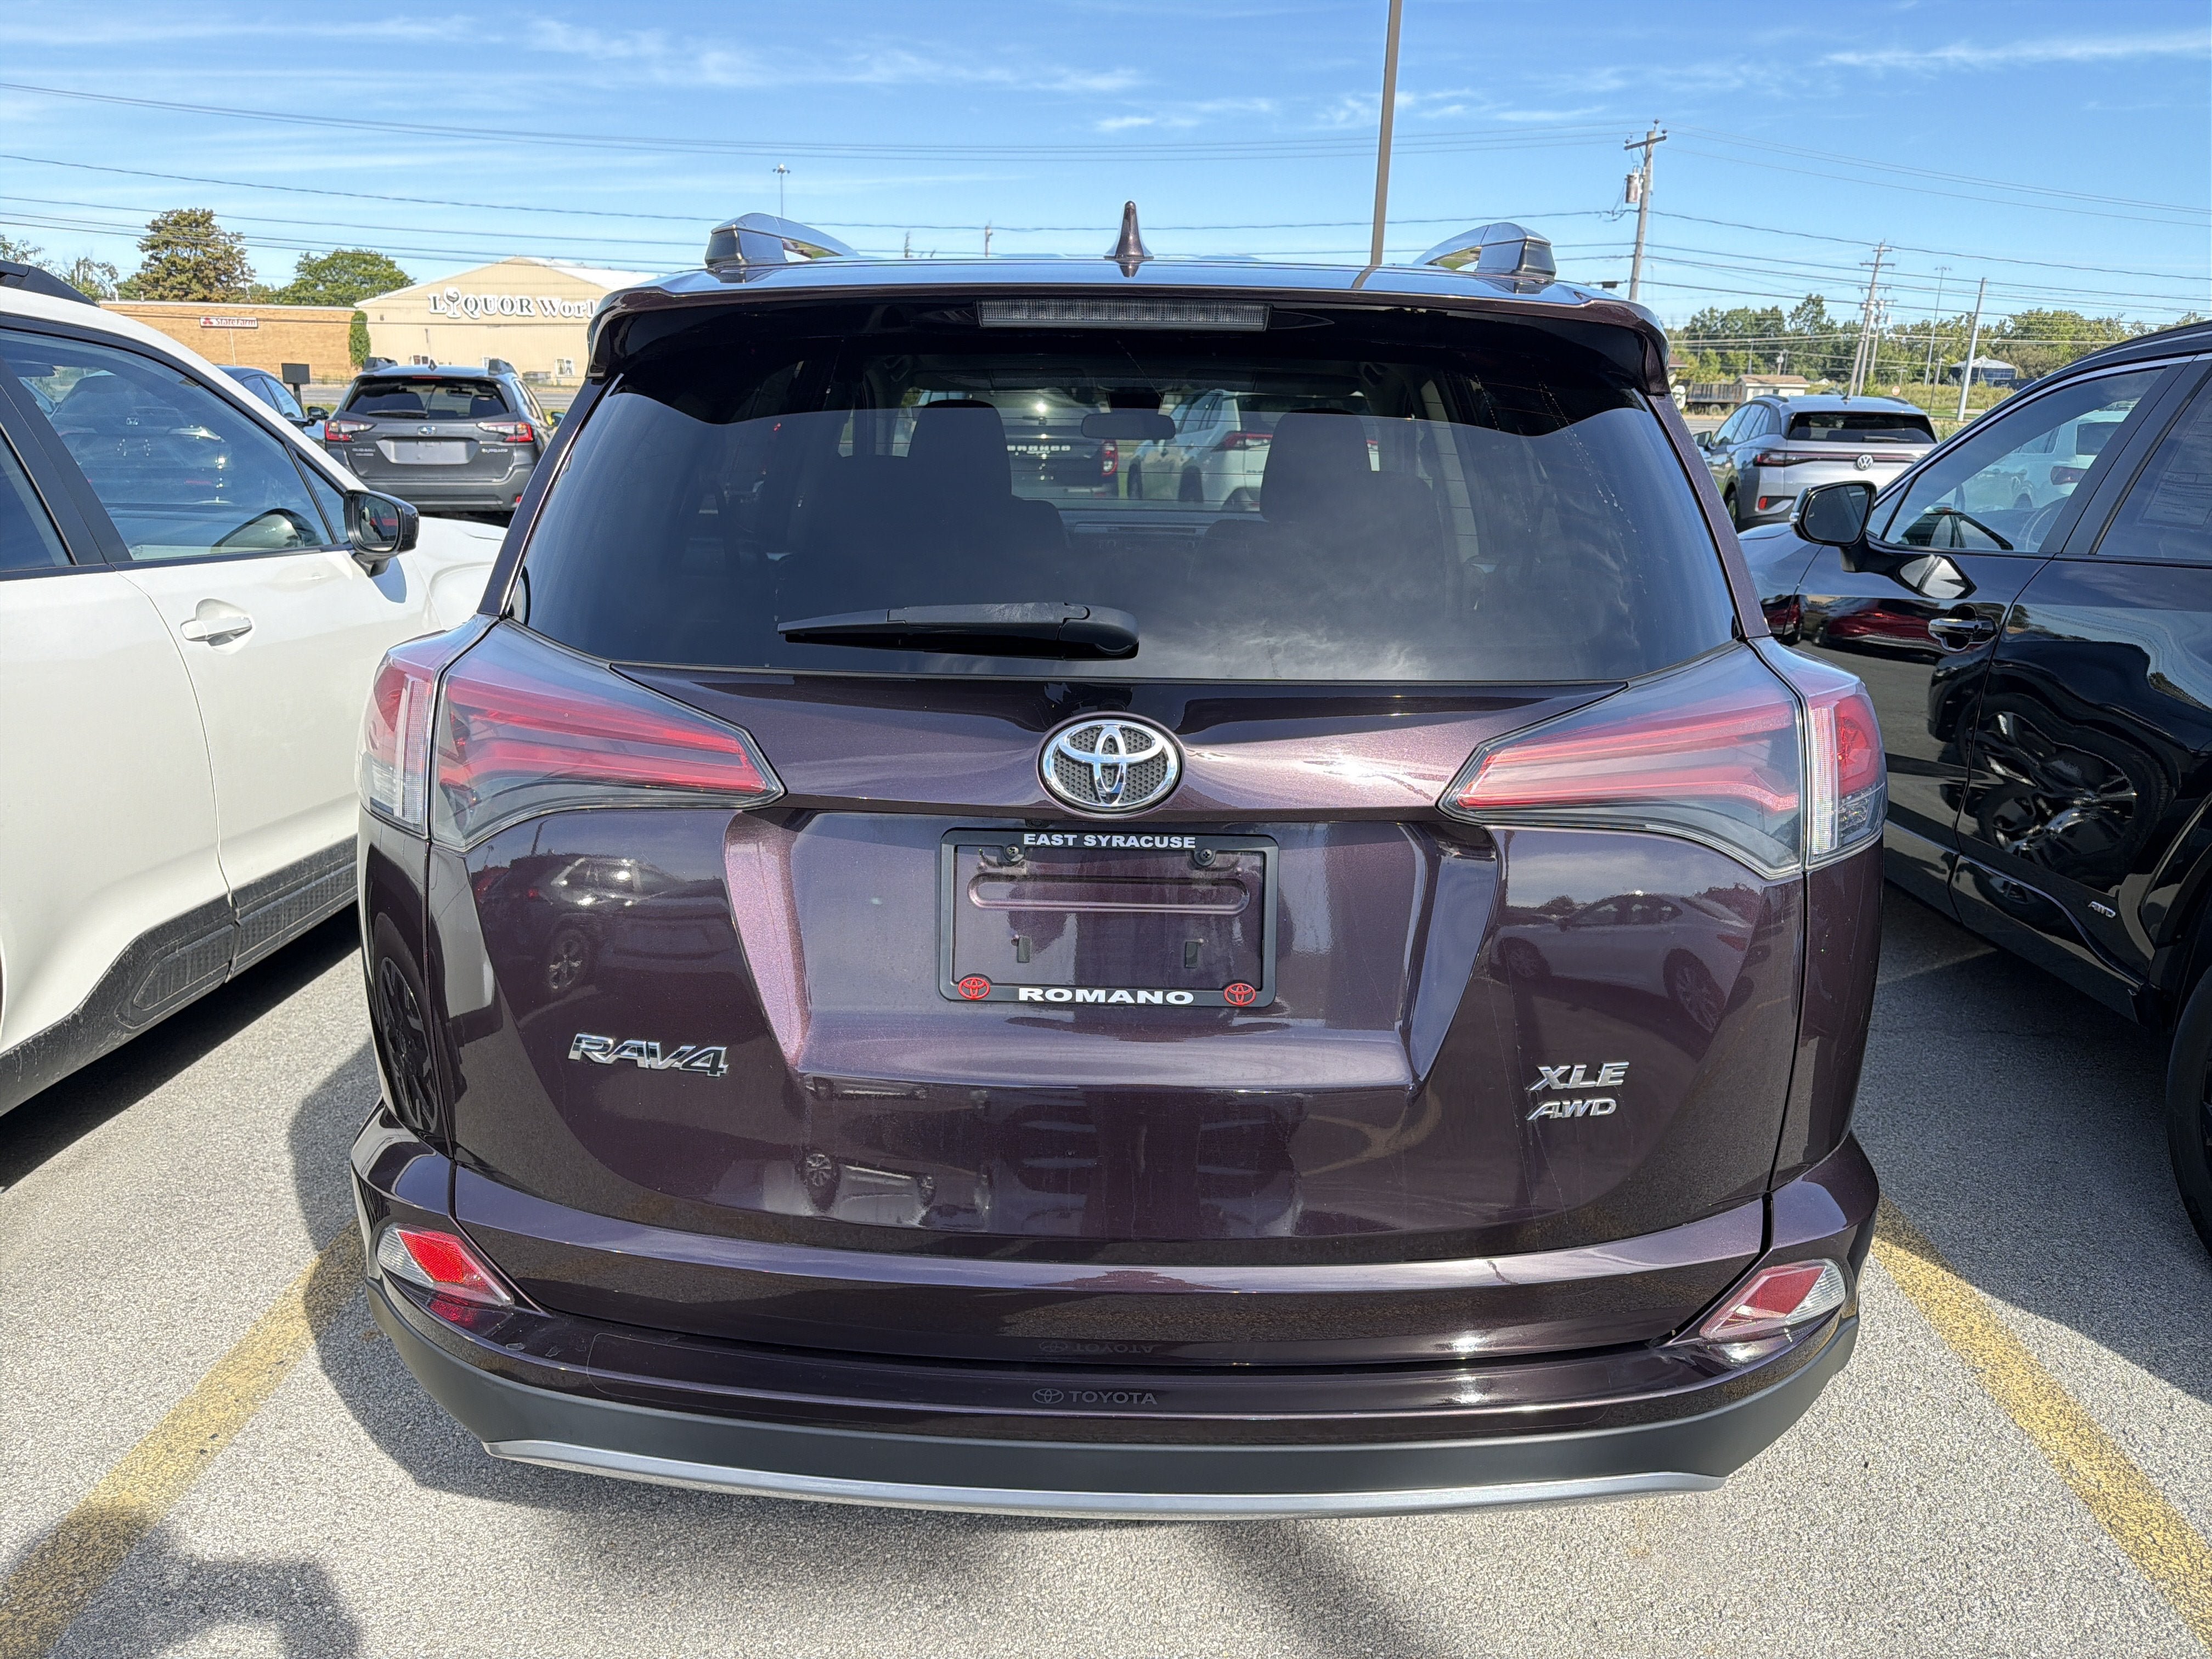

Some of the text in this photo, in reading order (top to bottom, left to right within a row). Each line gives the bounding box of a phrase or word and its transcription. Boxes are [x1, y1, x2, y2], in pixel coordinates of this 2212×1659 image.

[536, 297, 597, 318] Worl
[1023, 833, 1196, 849] EAST SYRACUSE
[1019, 988, 1194, 1005] ROMANO
[568, 1033, 729, 1077] RAV4
[1525, 1061, 1629, 1091] XLE
[1525, 1097, 1616, 1121] AWD
[1069, 1391, 1158, 1405] TOYOTA
